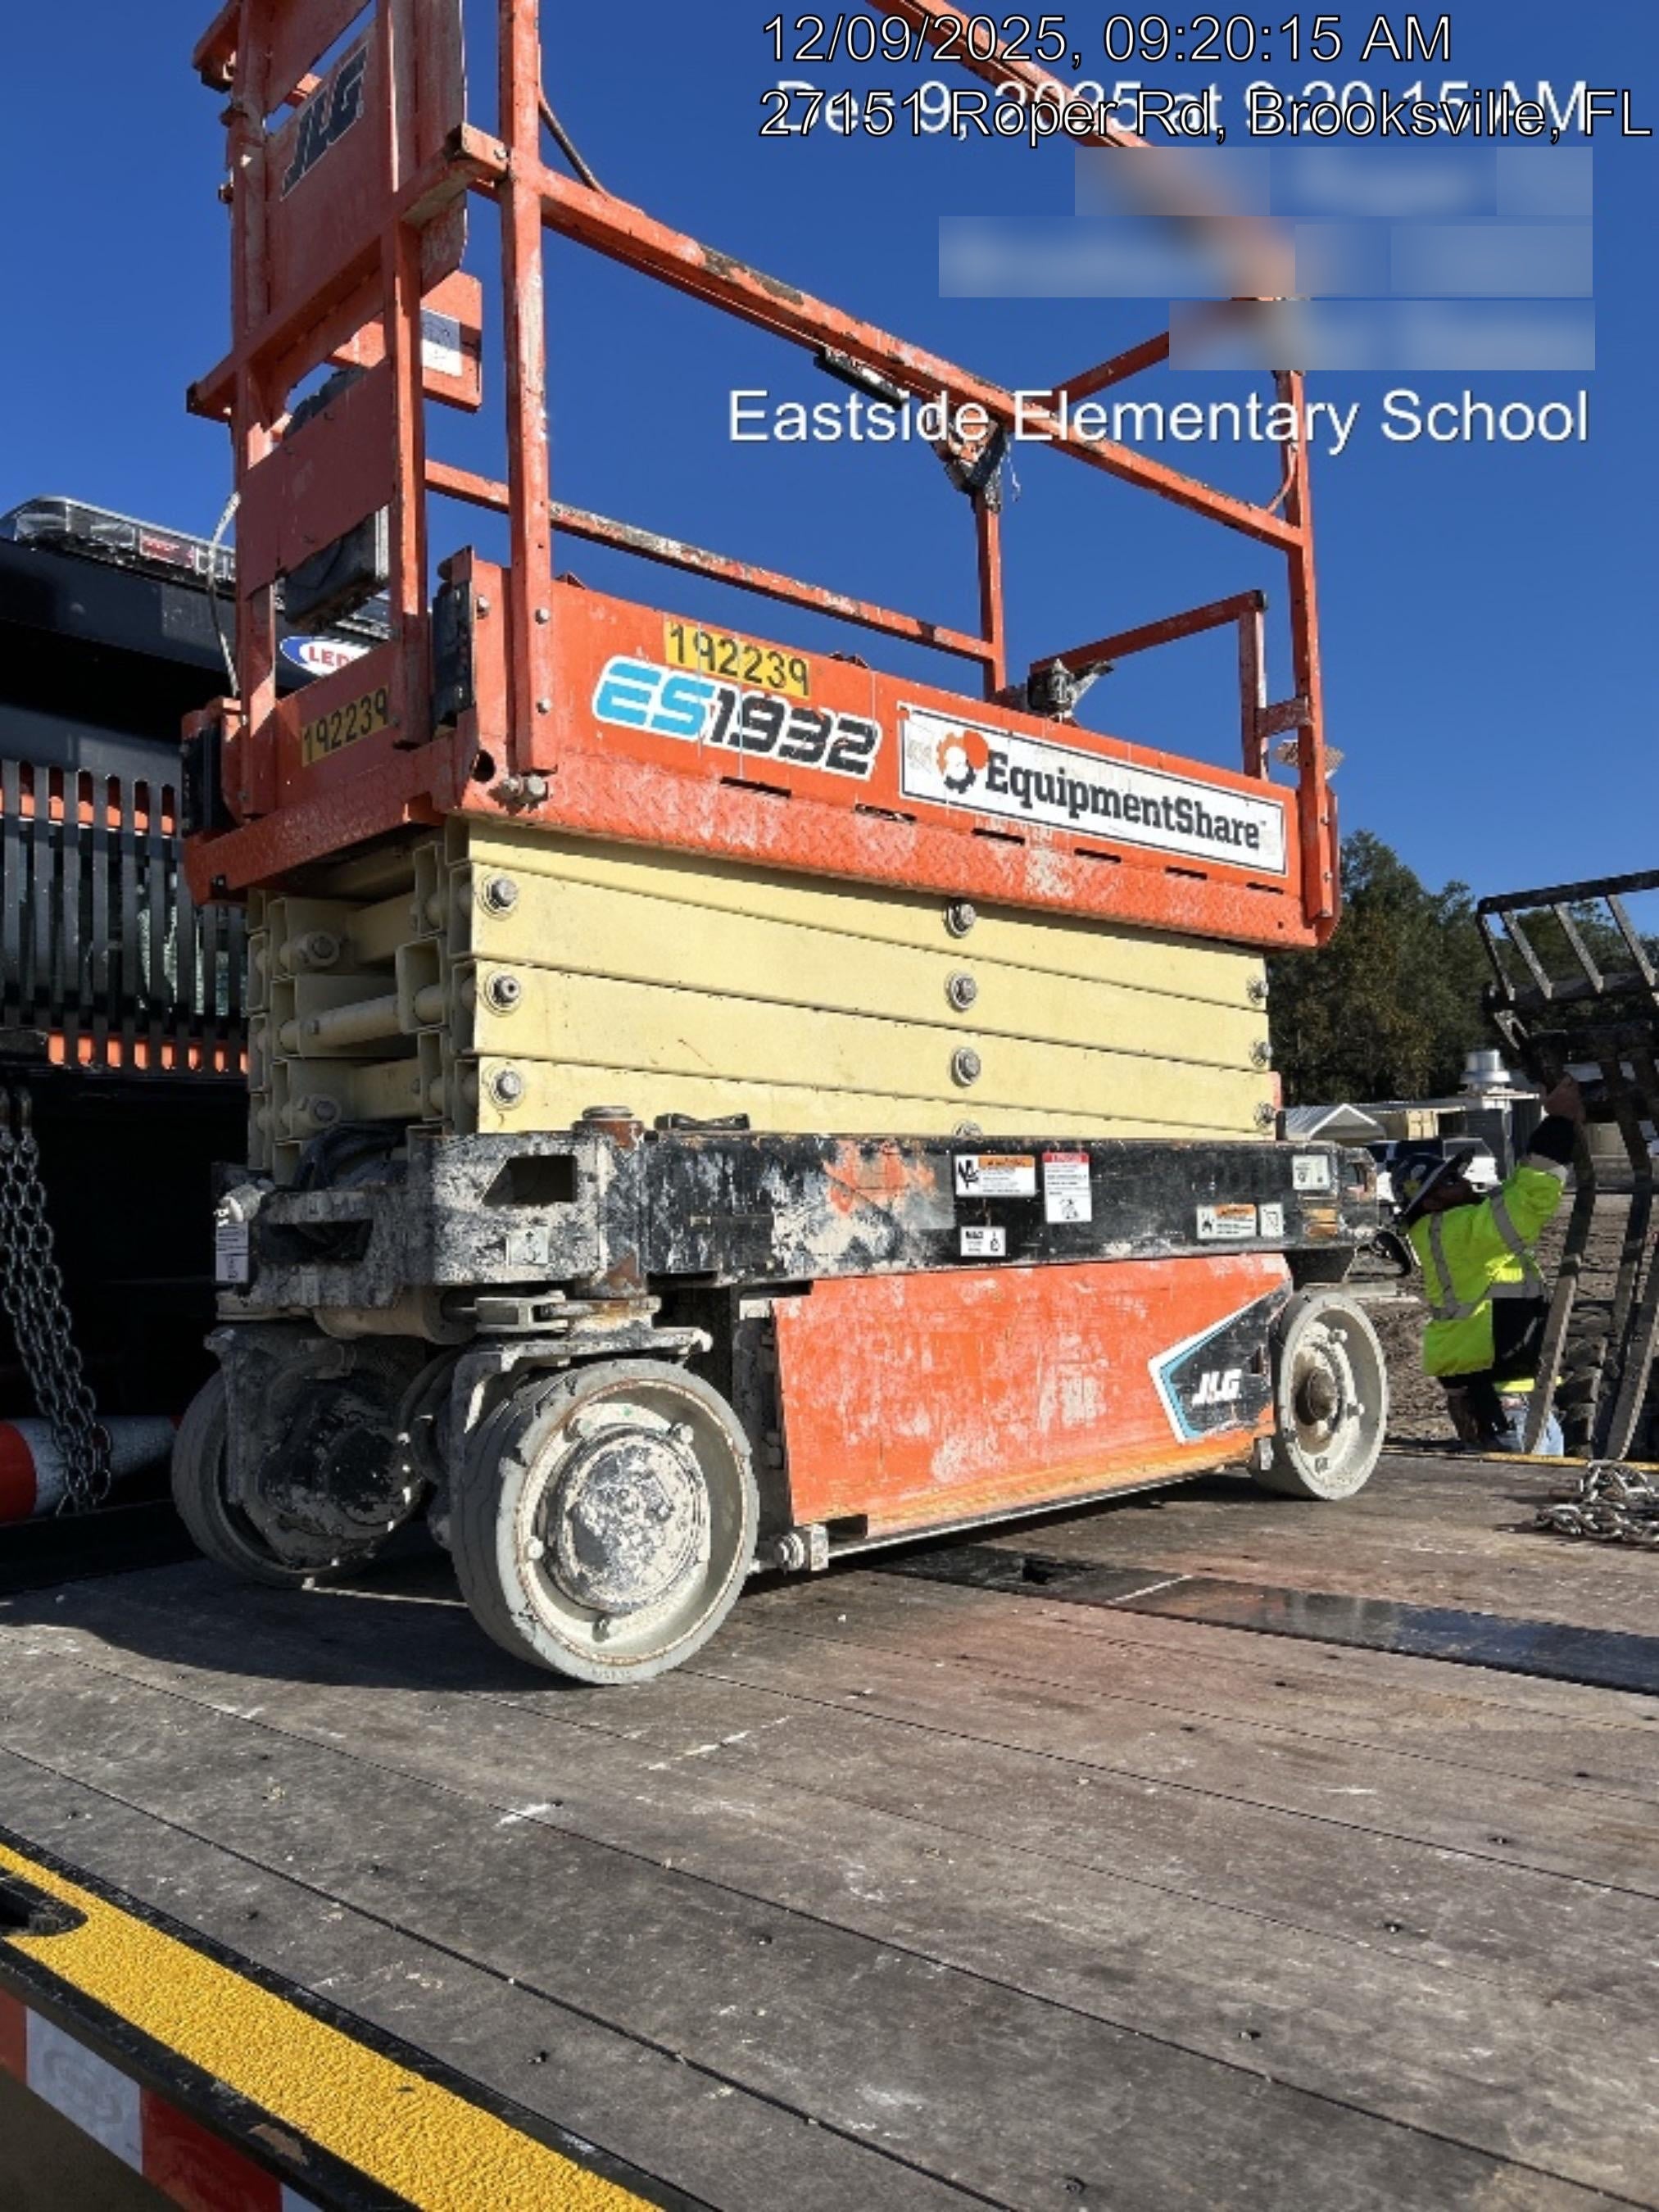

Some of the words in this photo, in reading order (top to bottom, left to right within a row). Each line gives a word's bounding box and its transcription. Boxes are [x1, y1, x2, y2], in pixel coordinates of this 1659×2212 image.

[281, 42, 369, 200] JLG
[669, 623, 810, 696] 192239
[303, 687, 388, 762] 192239
[593, 656, 880, 779] ES1932
[984, 750, 1262, 850] EquipmentShare
[1191, 1367, 1243, 1407] JLG
